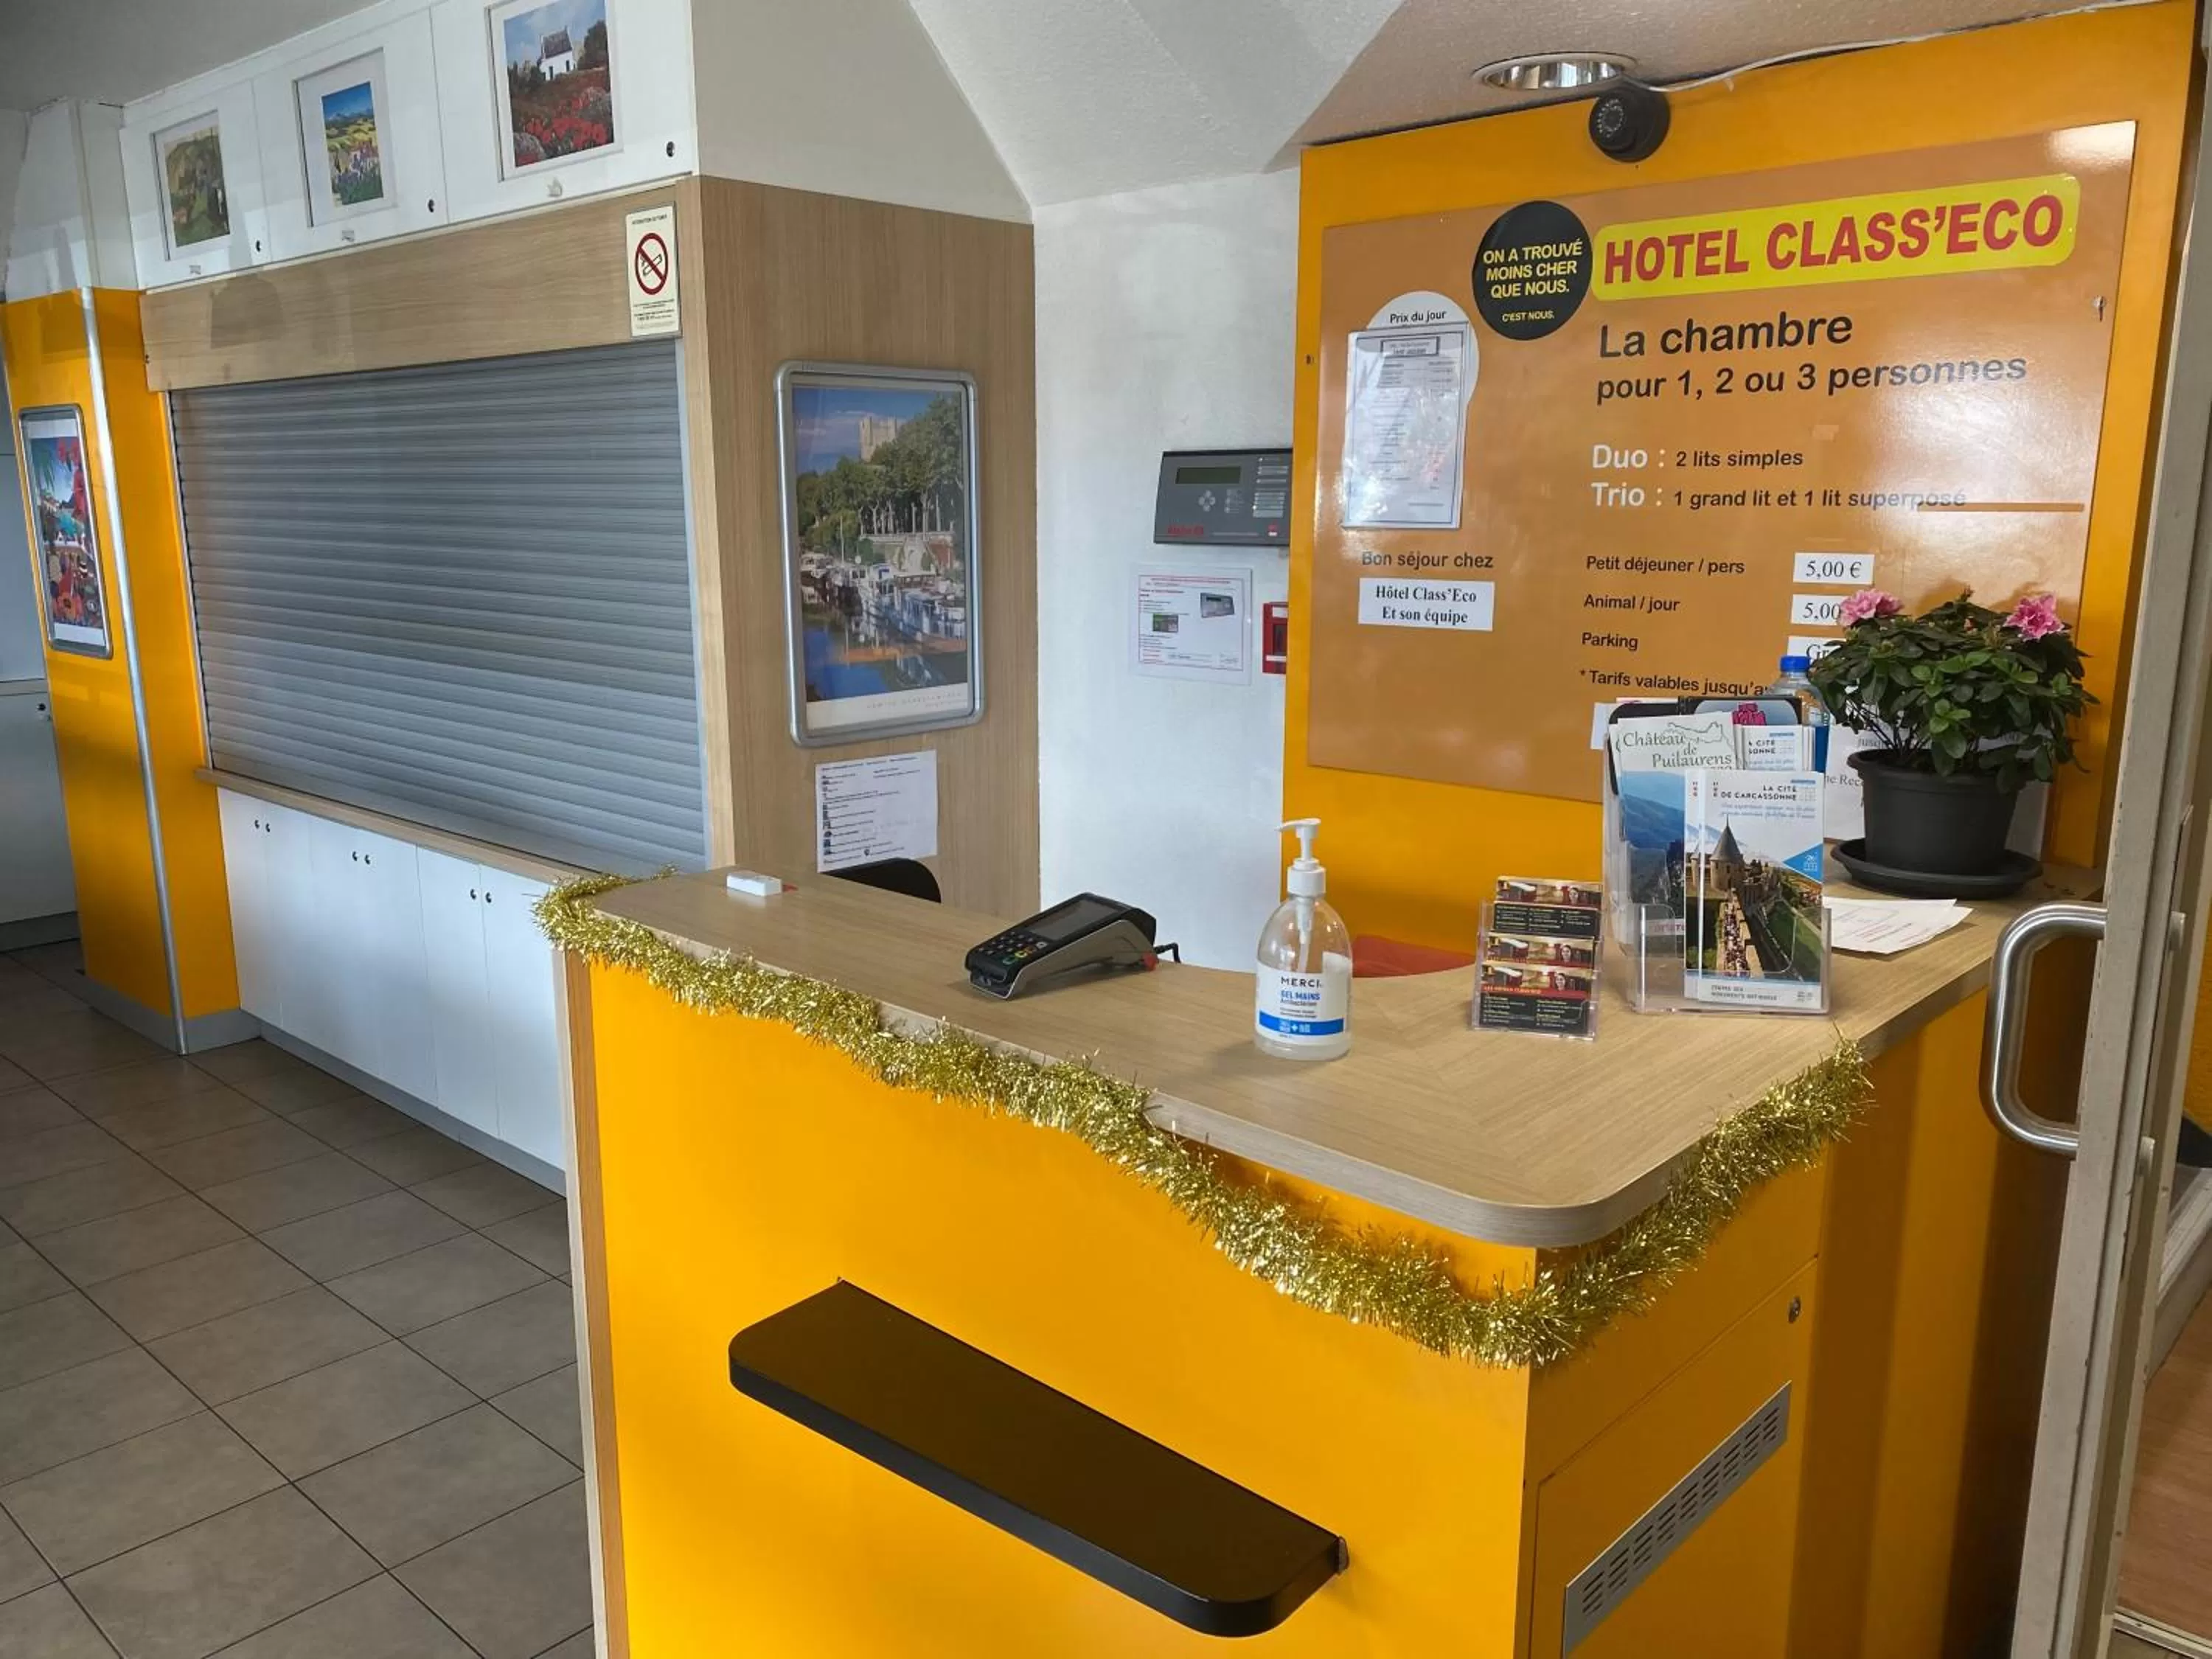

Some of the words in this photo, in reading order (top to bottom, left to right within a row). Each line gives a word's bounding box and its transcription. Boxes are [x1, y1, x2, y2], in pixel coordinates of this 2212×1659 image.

[1604, 229, 1749, 285] HOTEL
[1766, 195, 2064, 270] CLASS'ECO
[1484, 250, 1504, 263] ON
[1508, 248, 1518, 261] A
[1522, 238, 1582, 260] TROUVÉ
[1486, 265, 1532, 281] MOINS
[1536, 260, 1577, 276] CHER
[1491, 283, 1522, 299] QUE
[1526, 279, 1570, 296] NOUS.
[1390, 313, 1408, 323] Prix
[1411, 311, 1423, 321] du
[1426, 310, 1447, 322] jour
[1600, 324, 1644, 358] La
[1660, 311, 1852, 353] chambre
[1597, 377, 1666, 405] pour
[1677, 370, 1703, 400] 1,
[1716, 368, 1733, 394] 2
[1745, 370, 1784, 394] ou
[1798, 364, 1816, 390] 3
[1828, 358, 2027, 396] personnes
[1592, 445, 1648, 469] Duo
[1676, 452, 1686, 466] 2
[1694, 451, 1720, 466] lits
[1728, 450, 1803, 469] simples
[1591, 481, 1644, 507] Trio
[1674, 491, 1682, 506] 1
[1690, 490, 1745, 509] grand
[1753, 490, 1770, 506] lit
[1778, 491, 1797, 506] et
[1804, 490, 1812, 506] 1
[1822, 490, 1841, 506] lit
[1848, 489, 1966, 510] superposé
[1362, 552, 1391, 566] Bon
[1398, 551, 1448, 570] séjour
[1454, 552, 1493, 568] chez
[1587, 556, 1619, 570] Petit
[1624, 557, 1694, 574] déjeuner
[1708, 562, 1745, 575] pers
[1806, 560, 1844, 580] 5,00
[1850, 561, 1862, 578] €
[1376, 585, 1409, 599] Hôtel
[1584, 594, 1635, 609] Animal
[1647, 597, 1680, 613] jour
[1382, 606, 1395, 619] Et
[1399, 610, 1420, 621] son
[1425, 608, 1468, 626] équipe
[1582, 632, 1638, 651] Parking
[1589, 670, 1630, 686] Tarifs
[1635, 675, 1700, 691] valables
[1623, 731, 1684, 748] Château
[1683, 743, 1697, 756] de
[1652, 752, 1732, 768] Puilaurens
